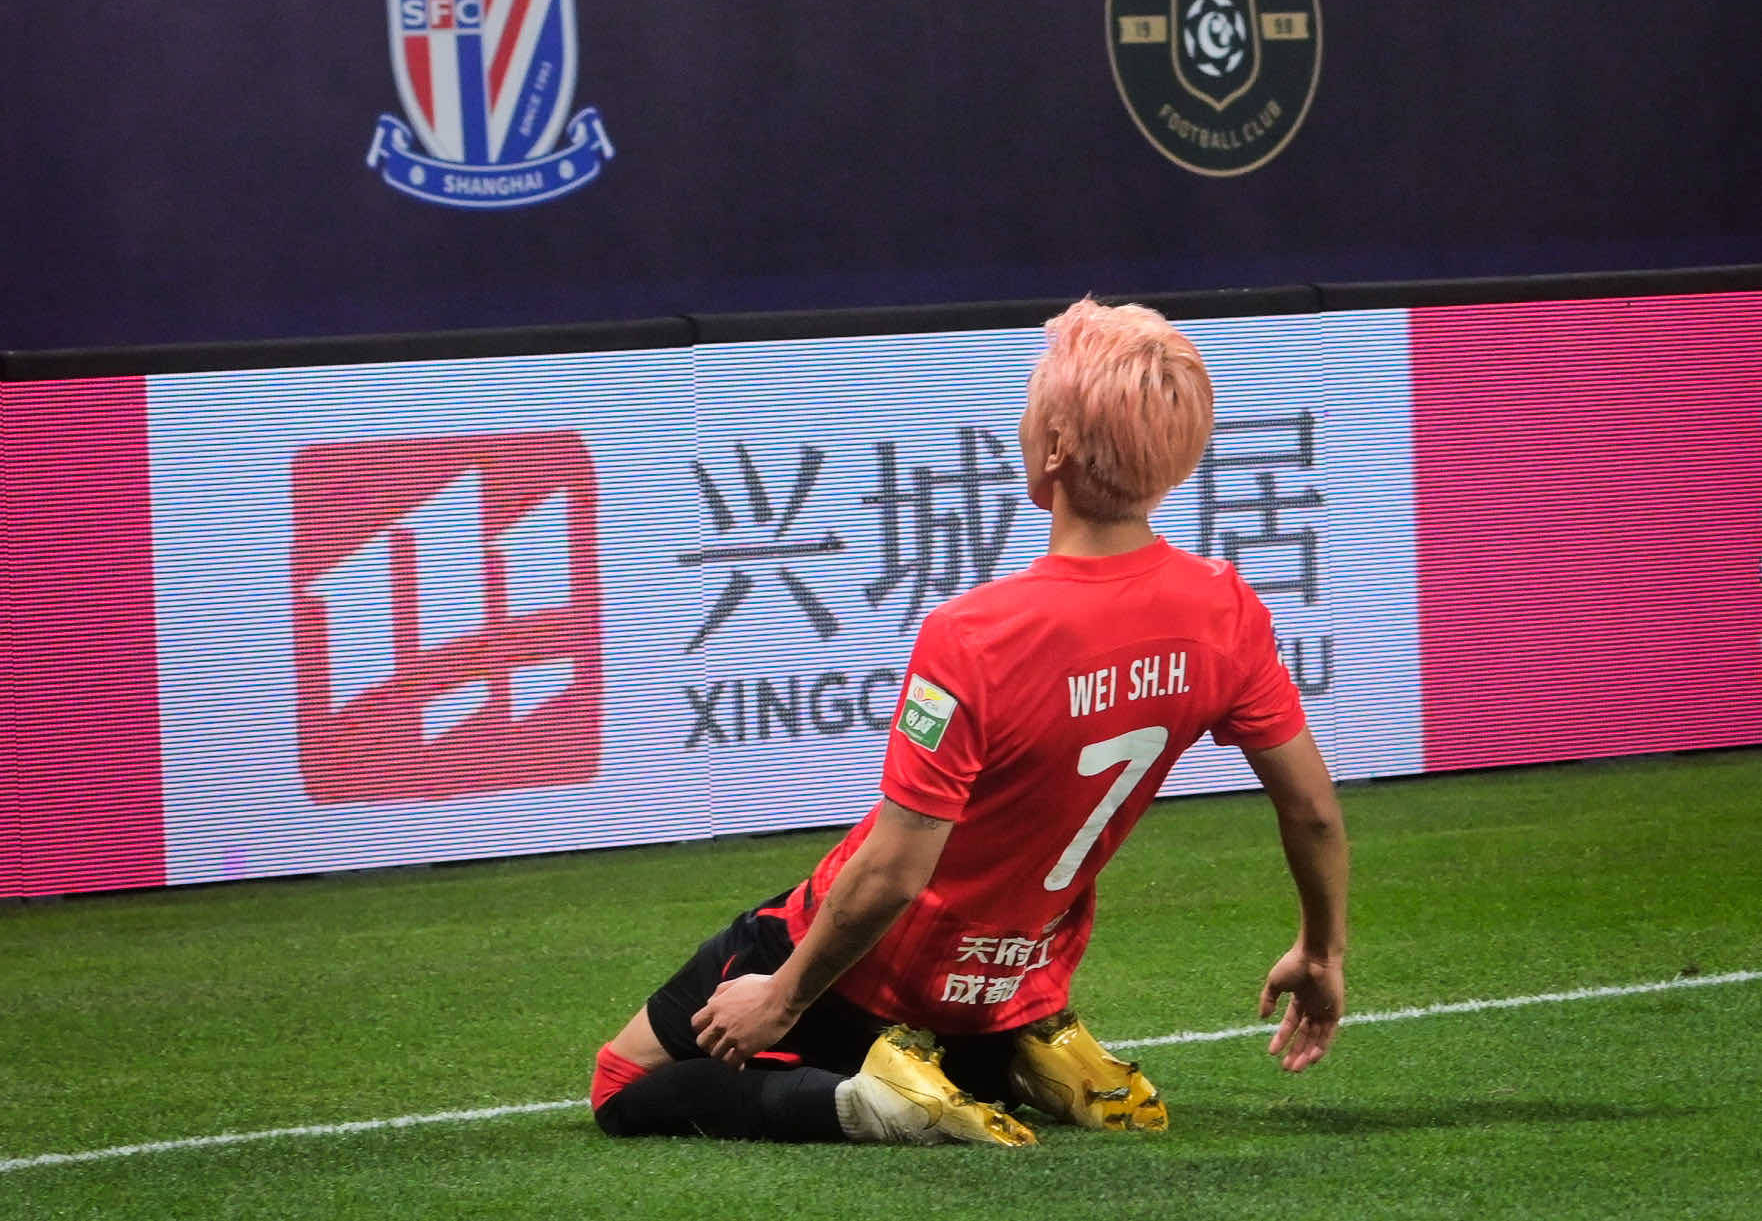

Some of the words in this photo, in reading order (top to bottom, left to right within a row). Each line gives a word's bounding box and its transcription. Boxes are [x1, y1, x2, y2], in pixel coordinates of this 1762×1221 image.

[1159, 103, 1242, 149] FOOTBALL
[1242, 100, 1281, 142] CLUB
[443, 170, 543, 196] SHANGHAI
[676, 406, 1326, 655] 兴城居
[684, 667, 897, 752] XINGC
[1067, 665, 1117, 718] WEI
[1127, 650, 1190, 701] SH.H.
[1044, 725, 1168, 891] 7
